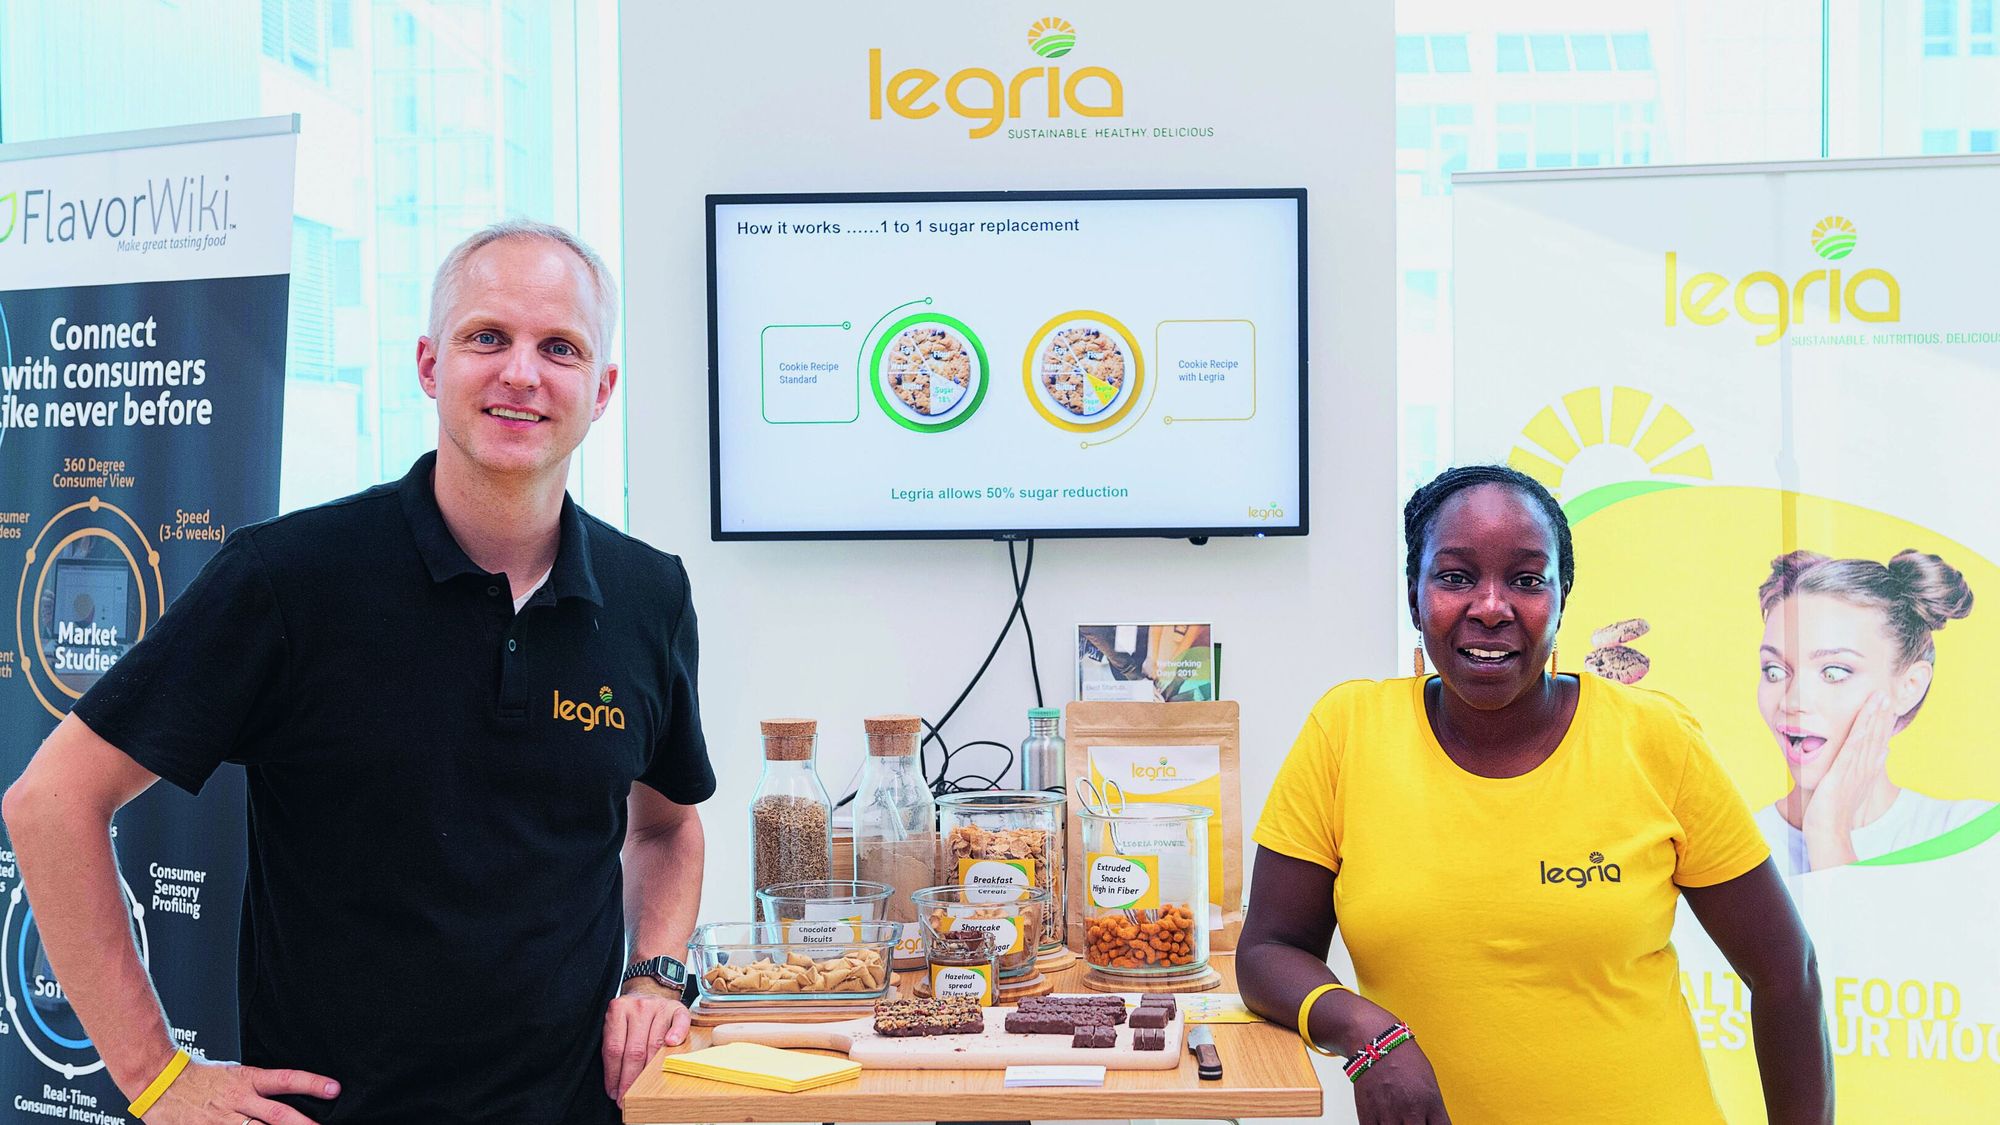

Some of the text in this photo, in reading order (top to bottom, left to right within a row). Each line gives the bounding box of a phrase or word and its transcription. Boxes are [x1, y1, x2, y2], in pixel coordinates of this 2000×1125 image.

[869, 48, 1124, 139] legria
[1153, 127, 1214, 138] DELICIOUS
[737, 221, 773, 235] How
[777, 221, 788, 234] it
[792, 221, 841, 235] works
[894, 221, 910, 234] to
[915, 220, 923, 233] 1
[929, 221, 975, 236] sugar
[980, 218, 1080, 235] replacement
[117, 233, 227, 254] Make great tasting food
[1664, 251, 1901, 346] legria
[50, 315, 157, 351] Connect
[2, 355, 206, 390] with consumers
[779, 362, 839, 373] Cookie Recipe
[1178, 359, 1239, 370] Cookie Recipe
[779, 375, 817, 384] Standard
[1178, 372, 1225, 383] with Legria
[0, 390, 213, 428] ike never before
[64, 458, 125, 476] 360 Degree
[53, 473, 135, 488] Consumer View
[891, 485, 1128, 502] Legria allows 50% sugar reduction
[175, 509, 210, 526] Speed
[1248, 506, 1284, 520] legria
[159, 525, 226, 543] (3-6 weeks)
[58, 621, 118, 647] Market
[55, 646, 118, 671] Studies
[553, 689, 625, 732] legria
[1131, 762, 1177, 781] legria
[149, 862, 206, 883] Consumer
[1097, 862, 1132, 872] Extruded
[1540, 861, 1621, 888] legria
[973, 876, 1013, 885] Breakfast
[1101, 874, 1126, 883] Snacks
[154, 879, 200, 903] Sensory
[978, 887, 1007, 895] Cereals
[1092, 884, 1139, 895] High in Fiber
[152, 895, 201, 920] Profiling
[961, 923, 1001, 932] Shortcake
[803, 935, 833, 943] Biscuits
[948, 982, 973, 990] spread
[1834, 976, 1961, 1022] FOOD
[1694, 1008, 1748, 1050] ES
[1834, 1015, 1891, 1058] UR
[43, 1084, 97, 1108] Real-Time
[14, 1095, 126, 1125] Consumer Interviews
